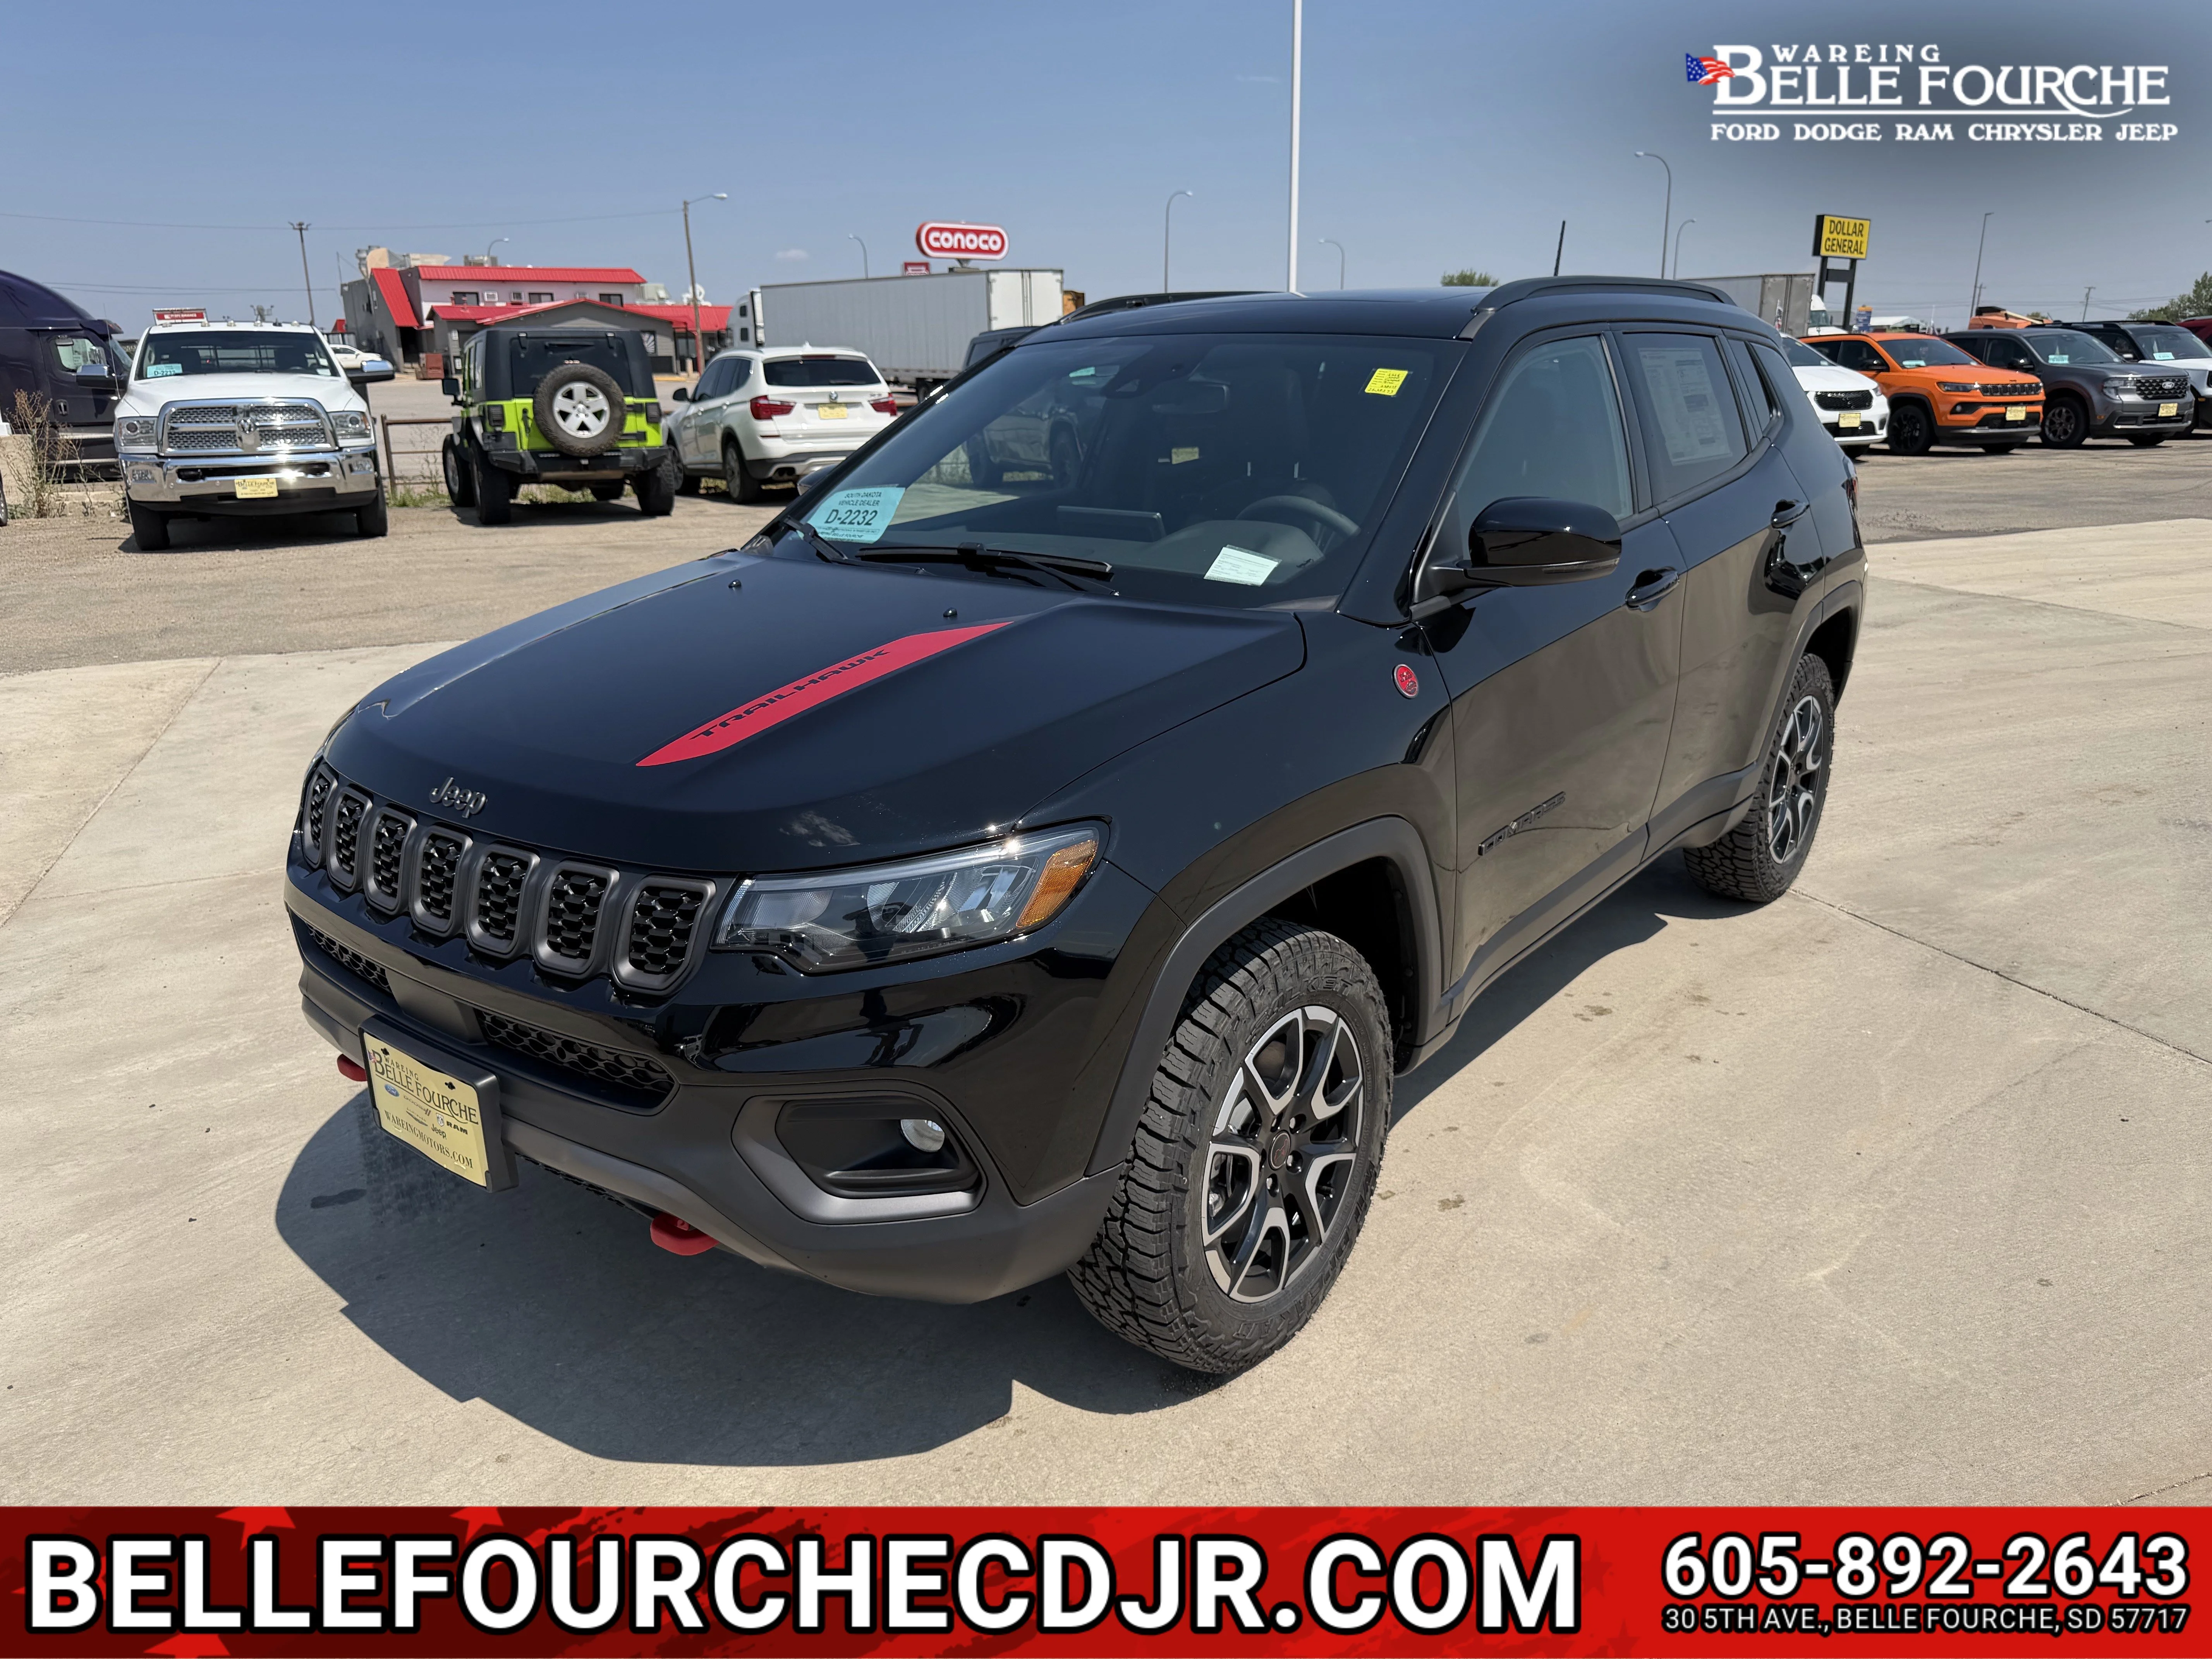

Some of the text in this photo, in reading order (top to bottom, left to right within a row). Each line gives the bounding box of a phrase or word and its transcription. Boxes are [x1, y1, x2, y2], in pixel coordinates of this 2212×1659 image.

[1829, 219, 1864, 237] DOLLAR
[1824, 237, 1863, 255] GENERAL
[824, 509, 878, 526] D-2232
[689, 650, 890, 740] TRAILHAWK
[429, 777, 487, 819] Jeep
[384, 1054, 419, 1081] WAREING
[372, 1049, 479, 1125] BELLE FOURCHE
[431, 1124, 447, 1140] Jeep
[446, 1120, 468, 1135] RAM
[384, 1110, 474, 1169] WAREINGMOTORS.COM
